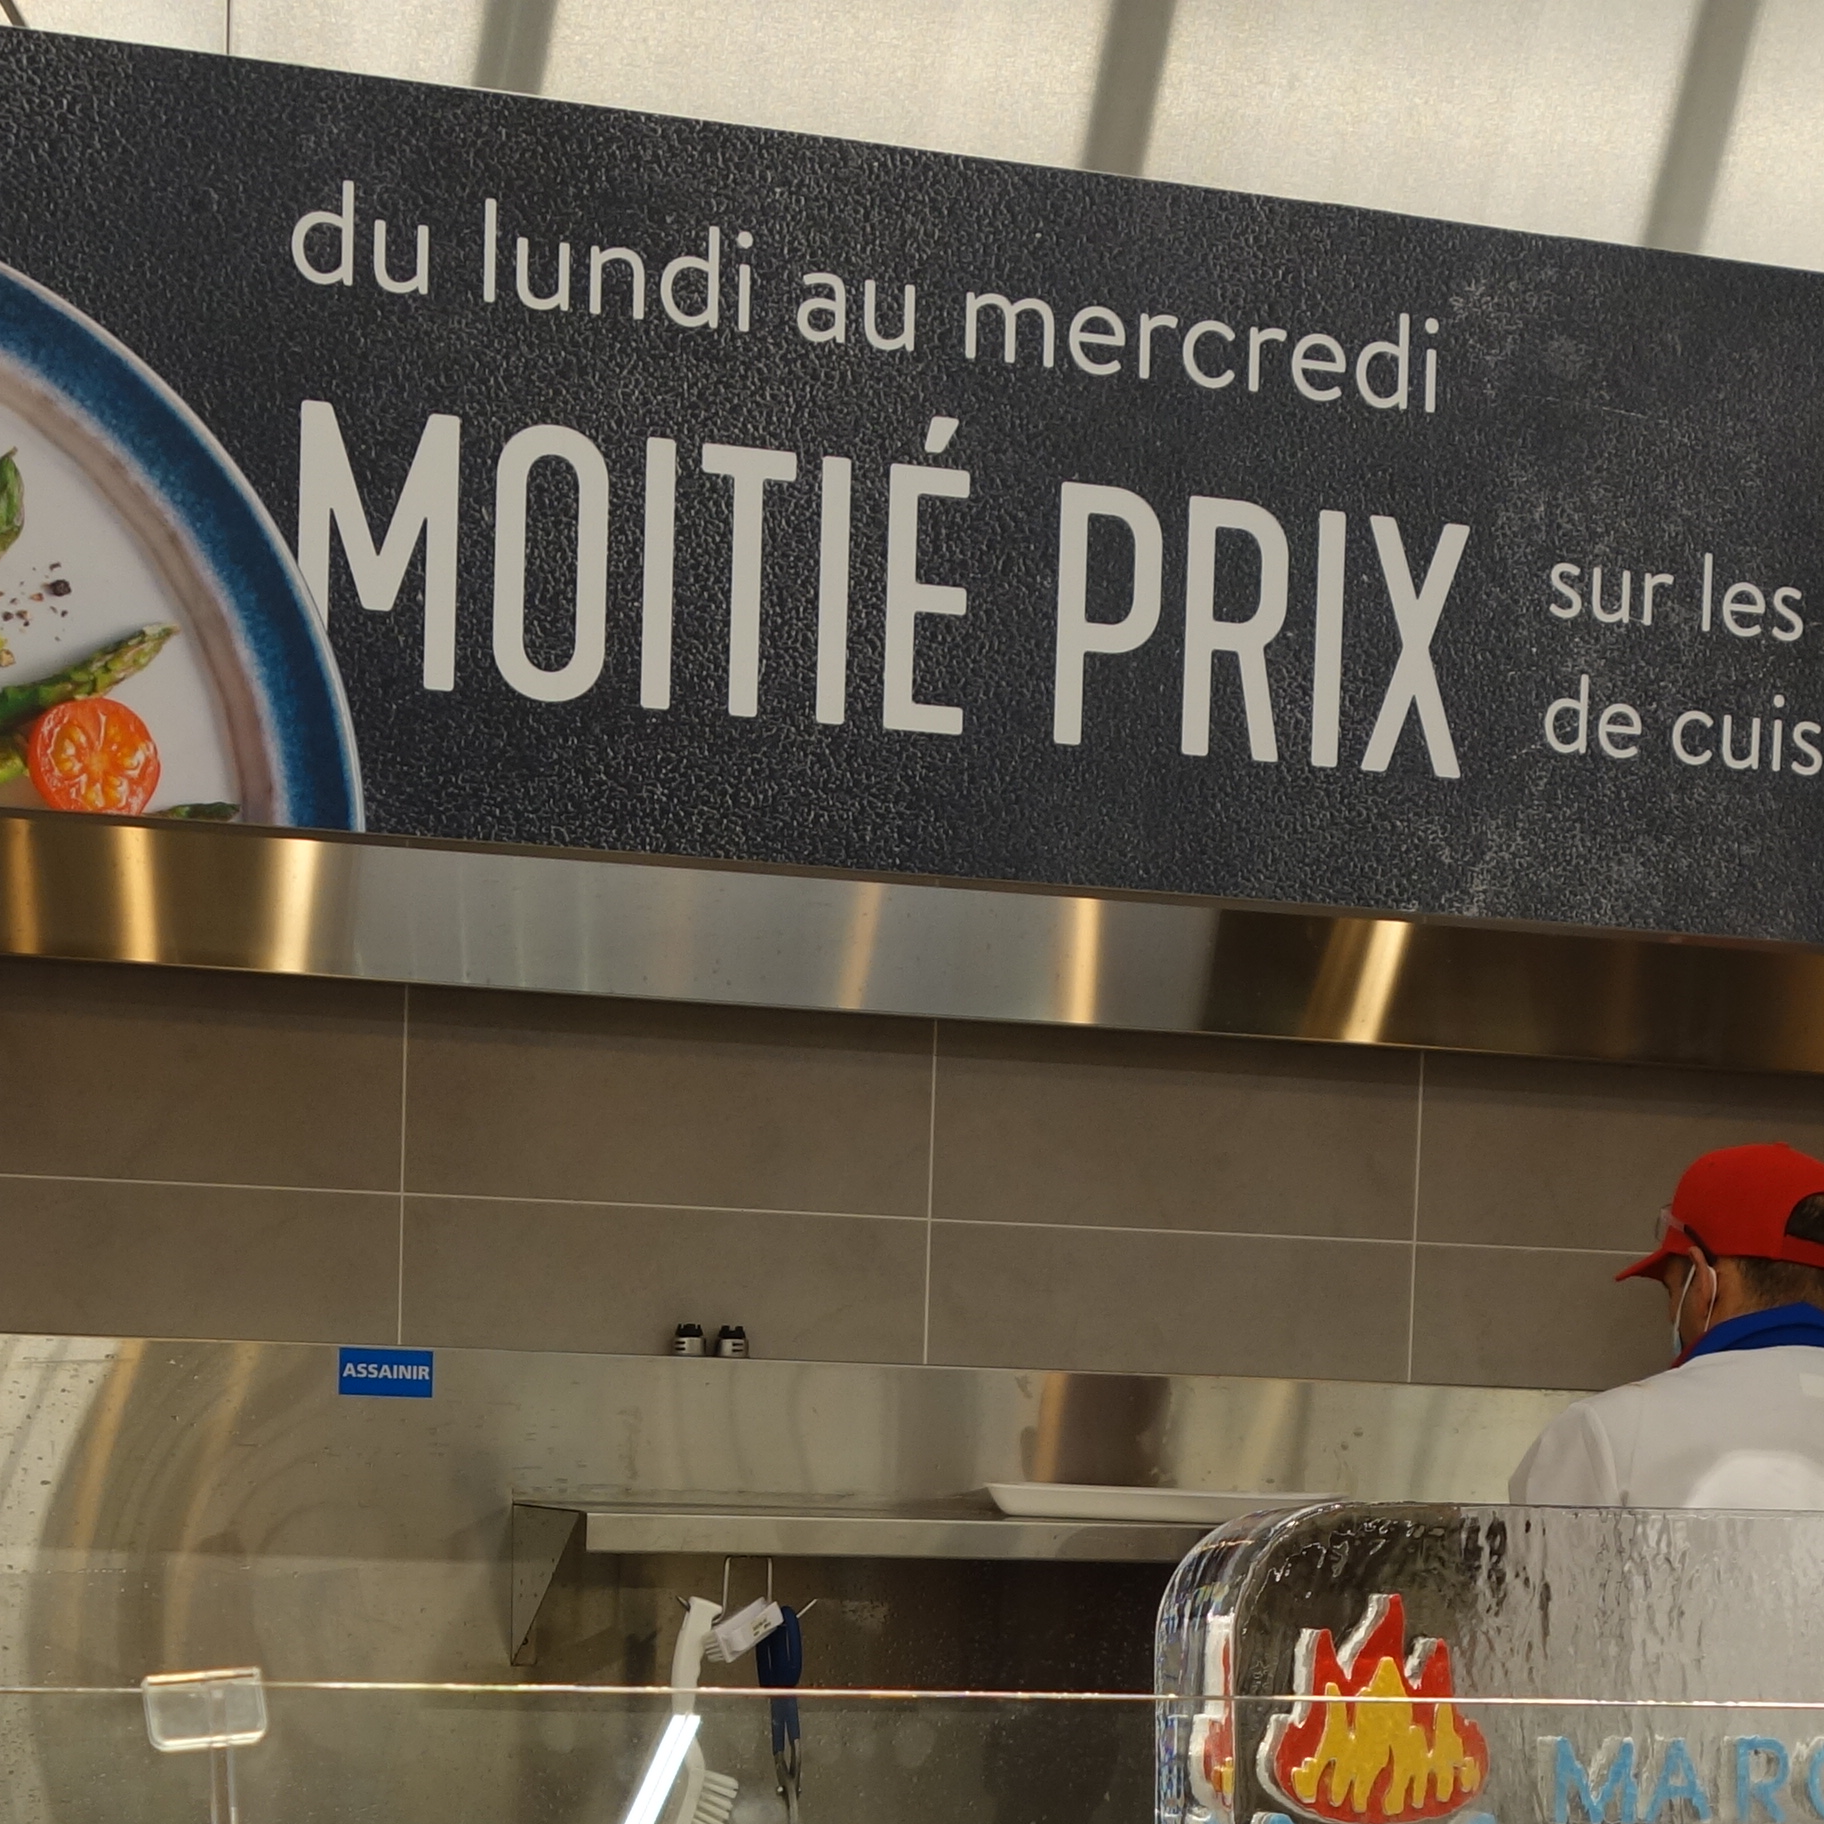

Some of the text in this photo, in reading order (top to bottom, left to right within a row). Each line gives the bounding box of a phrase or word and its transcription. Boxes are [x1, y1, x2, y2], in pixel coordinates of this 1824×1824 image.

[290, 180, 1440, 413] du lundi au mercredi
[296, 400, 1470, 780] MOITIÉ PRIX
[1547, 559, 1670, 628] sur
[1698, 553, 1805, 644] les
[1543, 675, 1642, 759] de
[342, 1361, 431, 1381] ASSAINIR
